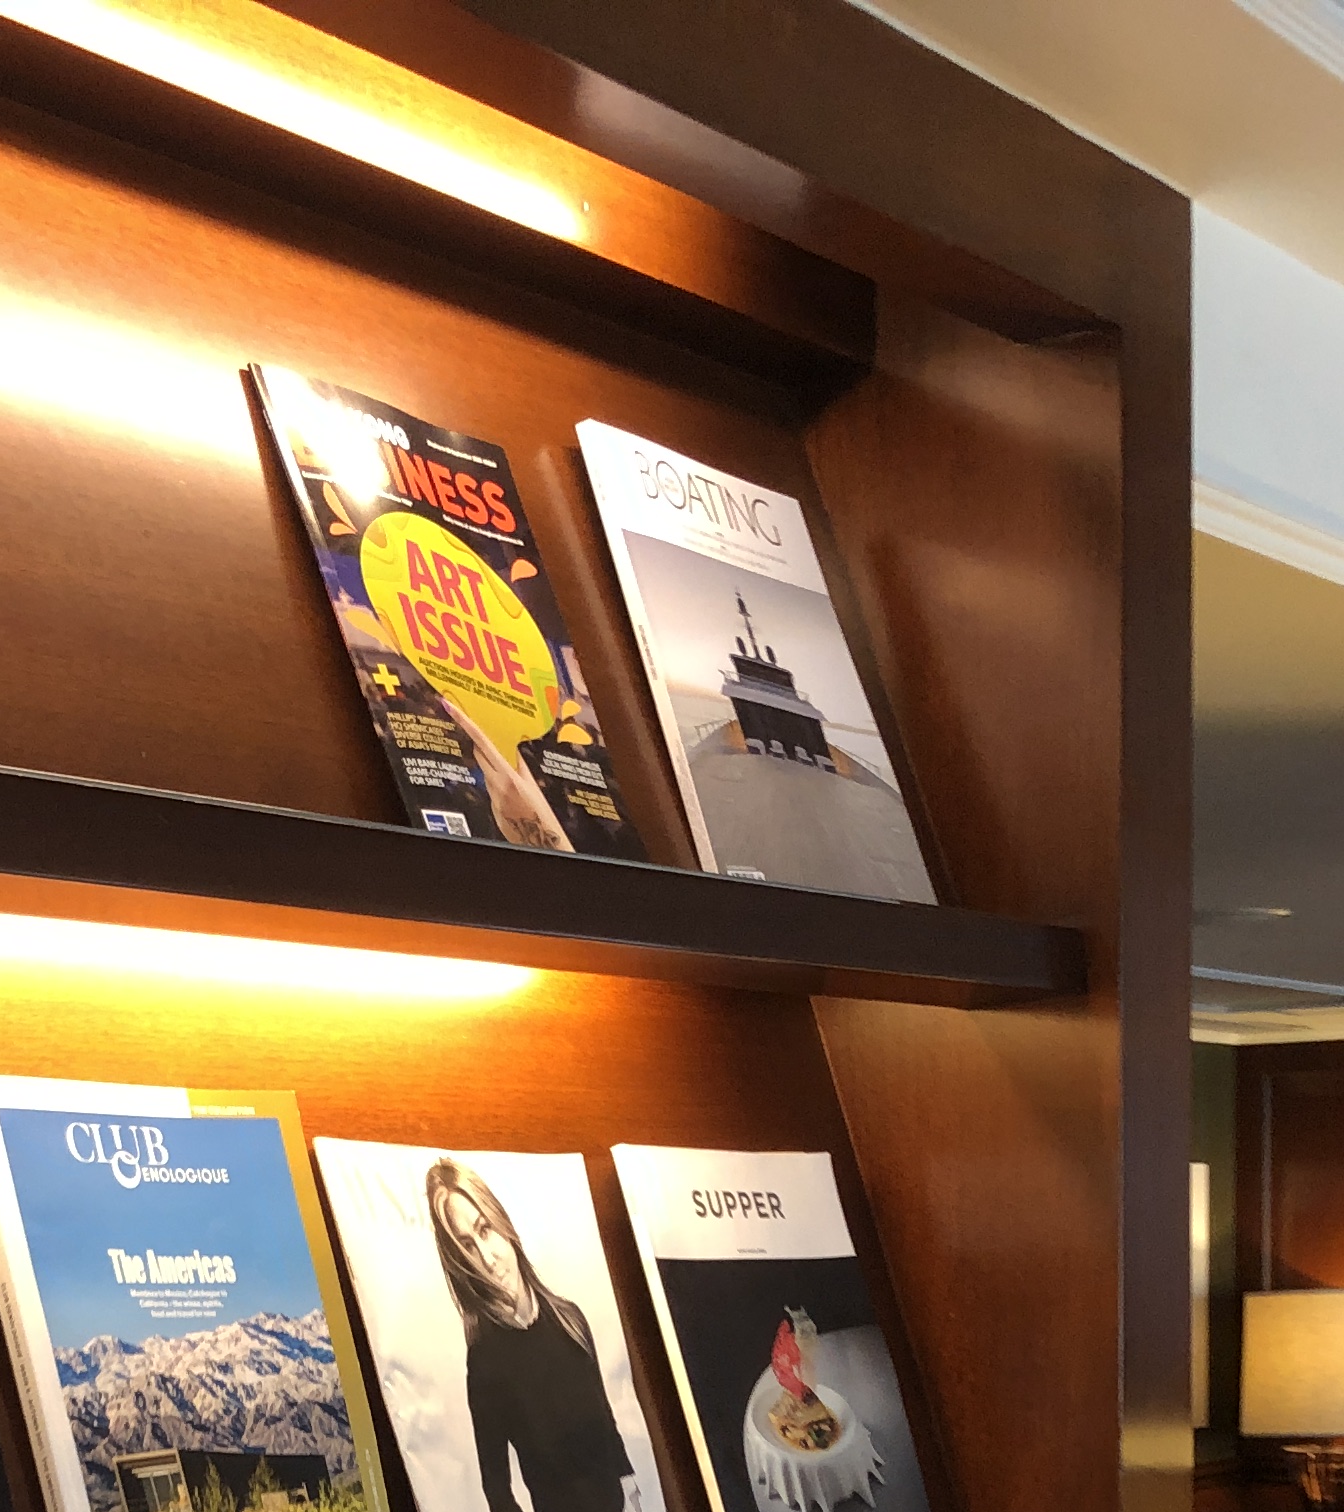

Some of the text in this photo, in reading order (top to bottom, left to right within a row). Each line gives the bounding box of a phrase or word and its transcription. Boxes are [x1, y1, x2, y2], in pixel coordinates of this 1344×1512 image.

[378, 440, 517, 533] INESS
[635, 450, 782, 547] BOATING
[406, 539, 490, 623] ART
[397, 592, 533, 697] ISSUE
[65, 1122, 169, 1166] CLUB
[692, 1189, 786, 1220] SUPPER
[108, 1248, 237, 1285] The Americas
